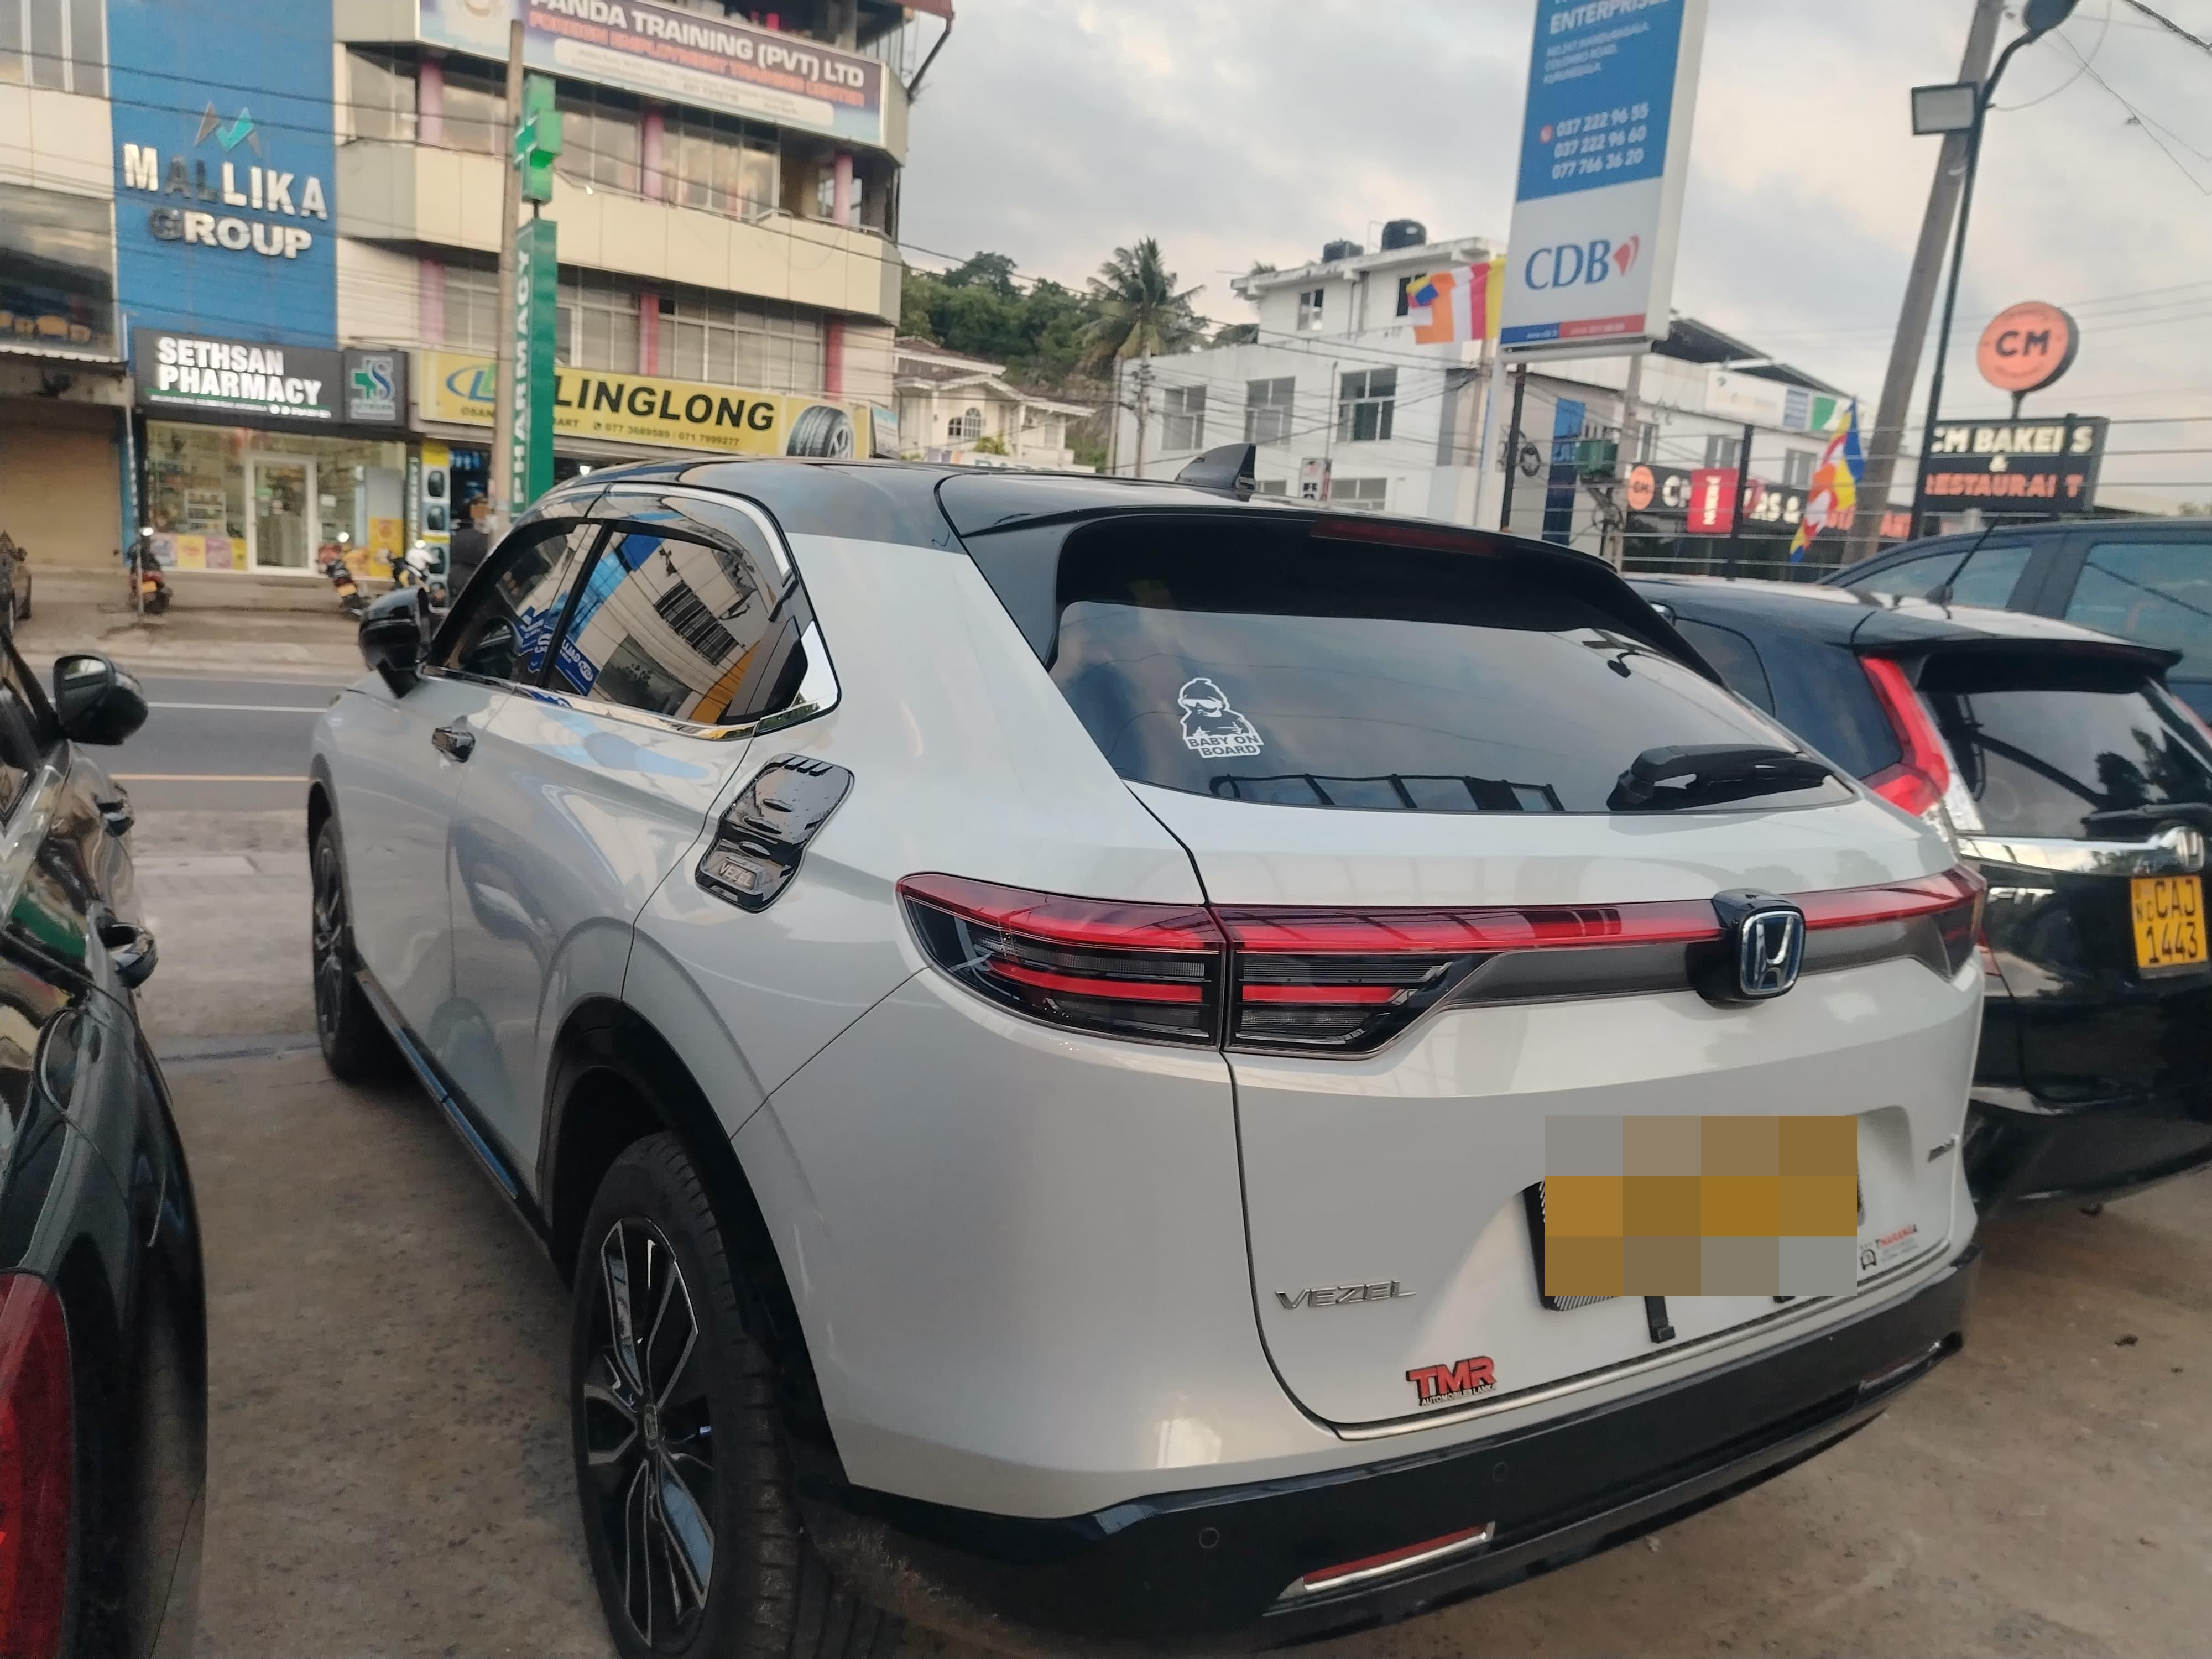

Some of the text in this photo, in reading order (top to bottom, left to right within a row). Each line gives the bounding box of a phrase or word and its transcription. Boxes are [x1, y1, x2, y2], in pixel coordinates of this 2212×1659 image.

[531, 0, 627, 29] ANDA
[631, 10, 753, 61] TRAINING
[758, 44, 820, 82] (PVT)
[824, 59, 864, 88] LTD
[1557, 118, 1582, 138] 037
[1583, 112, 1608, 132] 222
[1611, 107, 1629, 126] 96
[1554, 124, 1647, 159] 037 222 96 60
[1552, 160, 1577, 180] 077
[1578, 155, 1603, 175] 766
[1625, 147, 1644, 166] 20
[123, 143, 328, 221] MALLIKA
[149, 208, 312, 259] GROUP
[1524, 239, 1611, 290] CDB
[158, 336, 285, 376] SETHSAN
[1996, 330, 2051, 358] CM
[158, 364, 322, 406] PHARMACY
[514, 251, 530, 504] PHARMACY
[554, 375, 775, 431] LINGLONG
[604, 422, 624, 433] 077
[678, 432, 696, 441] 071
[1989, 455, 2009, 472] &
[1188, 735, 1260, 748] BABY ON
[1202, 745, 1257, 756] BOARD
[718, 862, 751, 887] VEZEL
[1987, 886, 2056, 905] FIT
[2146, 922, 2198, 964] 1443
[1274, 1279, 1417, 1311] VEZEL
[1405, 1355, 1498, 1399] TMR
[1420, 1389, 1473, 1407] AUTOMOBILES
